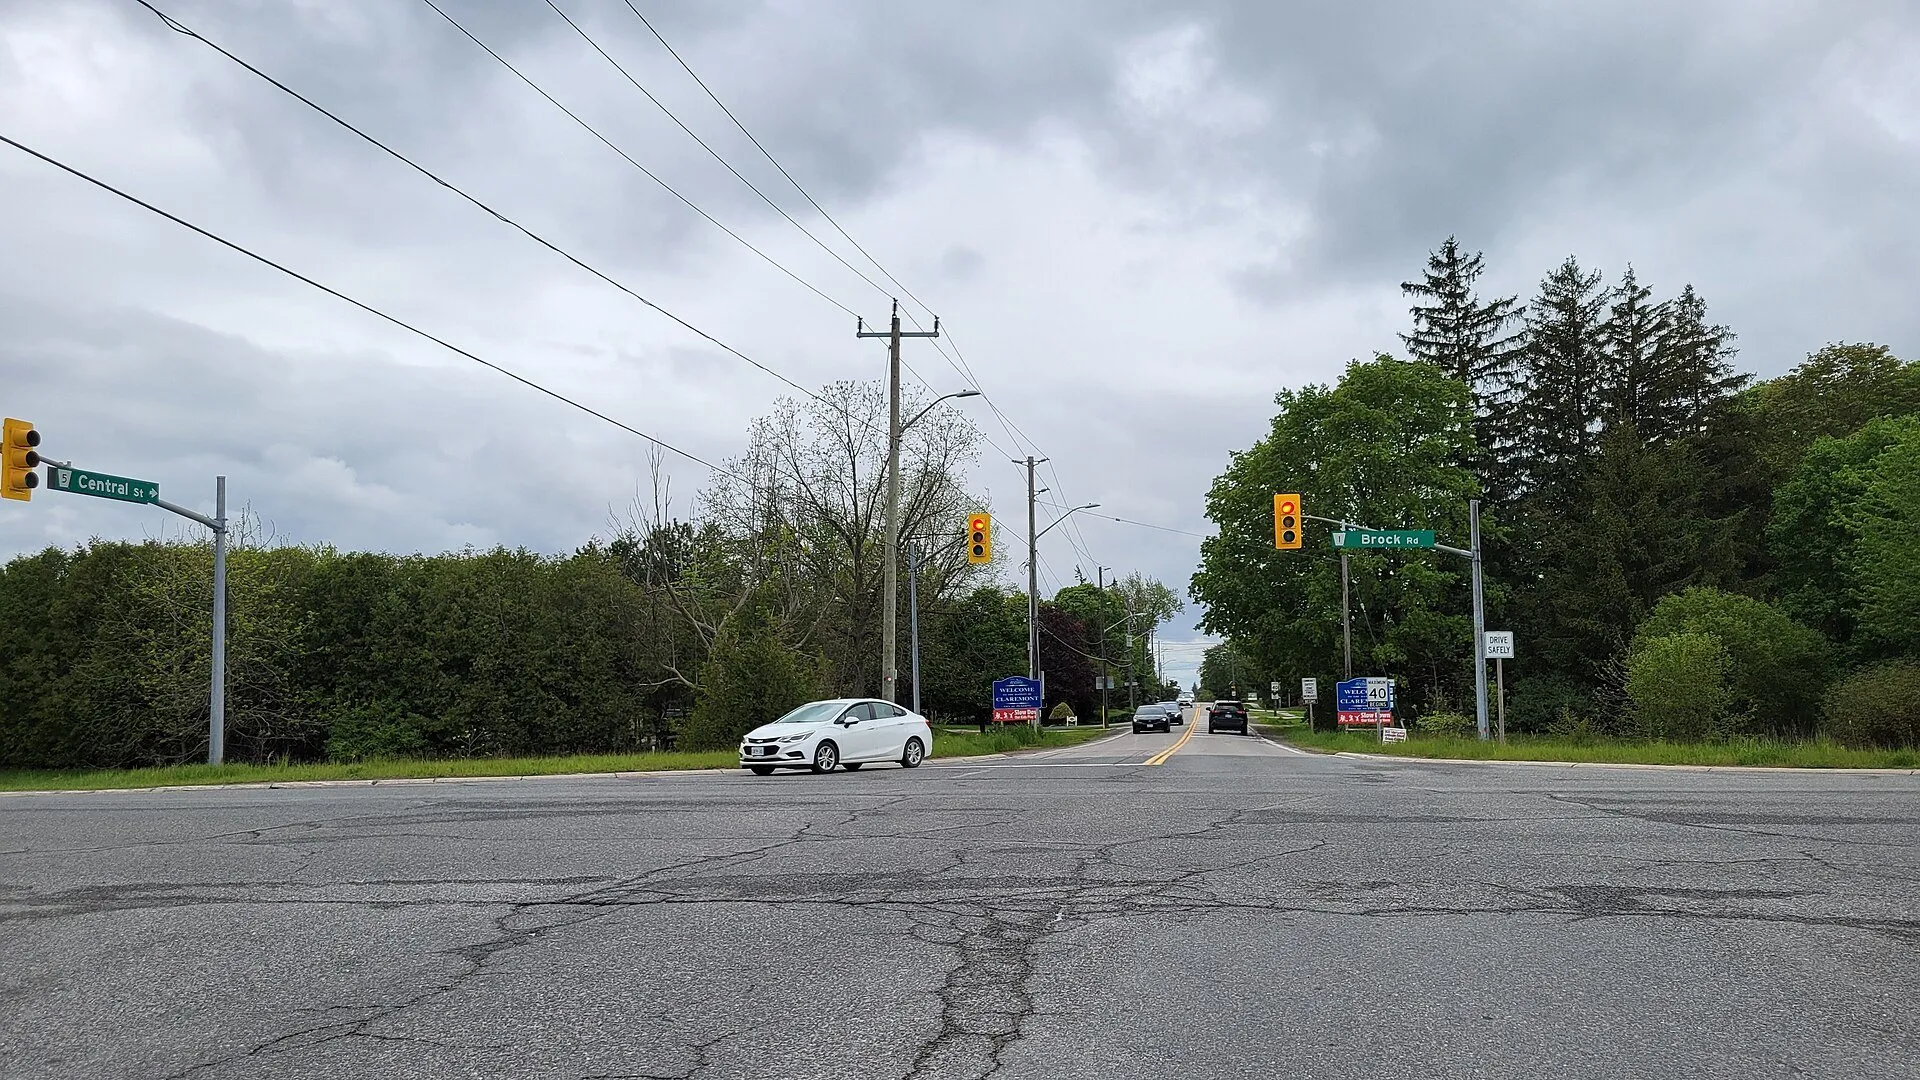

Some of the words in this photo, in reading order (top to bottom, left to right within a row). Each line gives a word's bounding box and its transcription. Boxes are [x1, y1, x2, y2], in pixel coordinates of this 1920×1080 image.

[62, 473, 68, 484] 5
[78, 474, 129, 495] Central
[133, 487, 144, 498] St
[1361, 533, 1401, 545] Brock
[1406, 537, 1419, 545] Rd
[1489, 636, 1508, 644] DRIVE
[1487, 646, 1511, 654] SAFELY
[1368, 687, 1387, 699] 40
